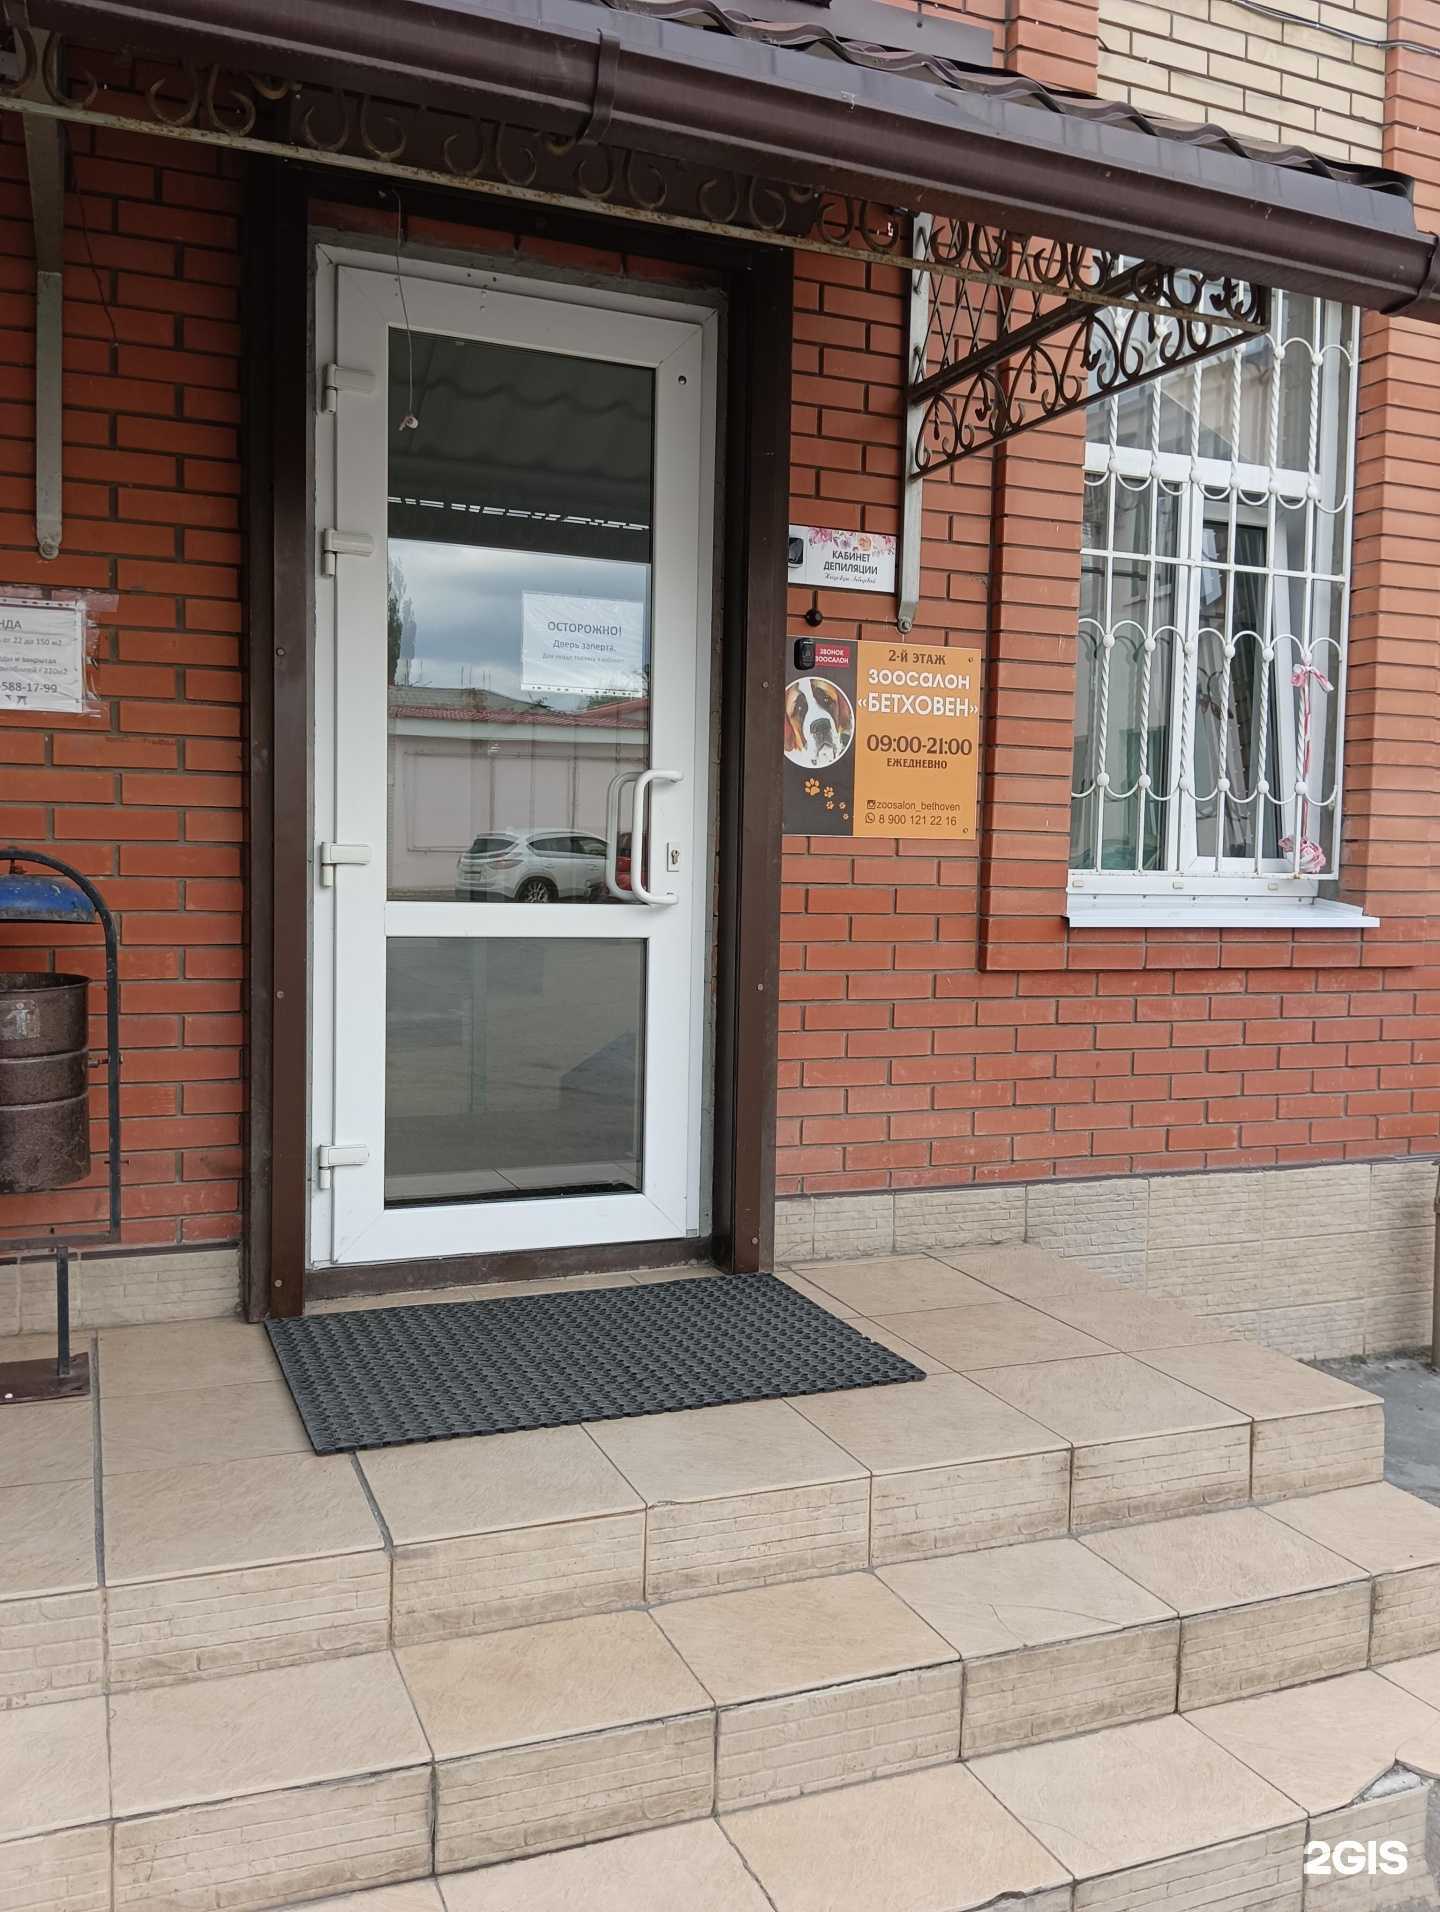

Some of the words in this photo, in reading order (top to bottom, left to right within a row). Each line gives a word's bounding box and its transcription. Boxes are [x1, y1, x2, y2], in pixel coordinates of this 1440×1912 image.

[832, 550, 871, 562] КАБИНЕТ
[823, 561, 878, 575] ДЕПИЛЯЦИИ
[547, 621, 622, 637] ОСТОРОЖНО!
[552, 640, 579, 649] Дверь
[820, 648, 844, 656] ЗВОНОК
[912, 653, 946, 665] ЭТАЖ
[857, 692, 979, 717] «БЕТХОВЕН»
[866, 734, 973, 756] 09:00-21:00
[886, 757, 948, 770] ЕЖЕДНЕВНО
[876, 801, 961, 812] zoosalon_bethoven
[878, 815, 885, 824] 8
[888, 815, 906, 825] 900
[909, 816, 926, 825] 121
[930, 816, 942, 826] 22
[945, 816, 957, 826] 16
